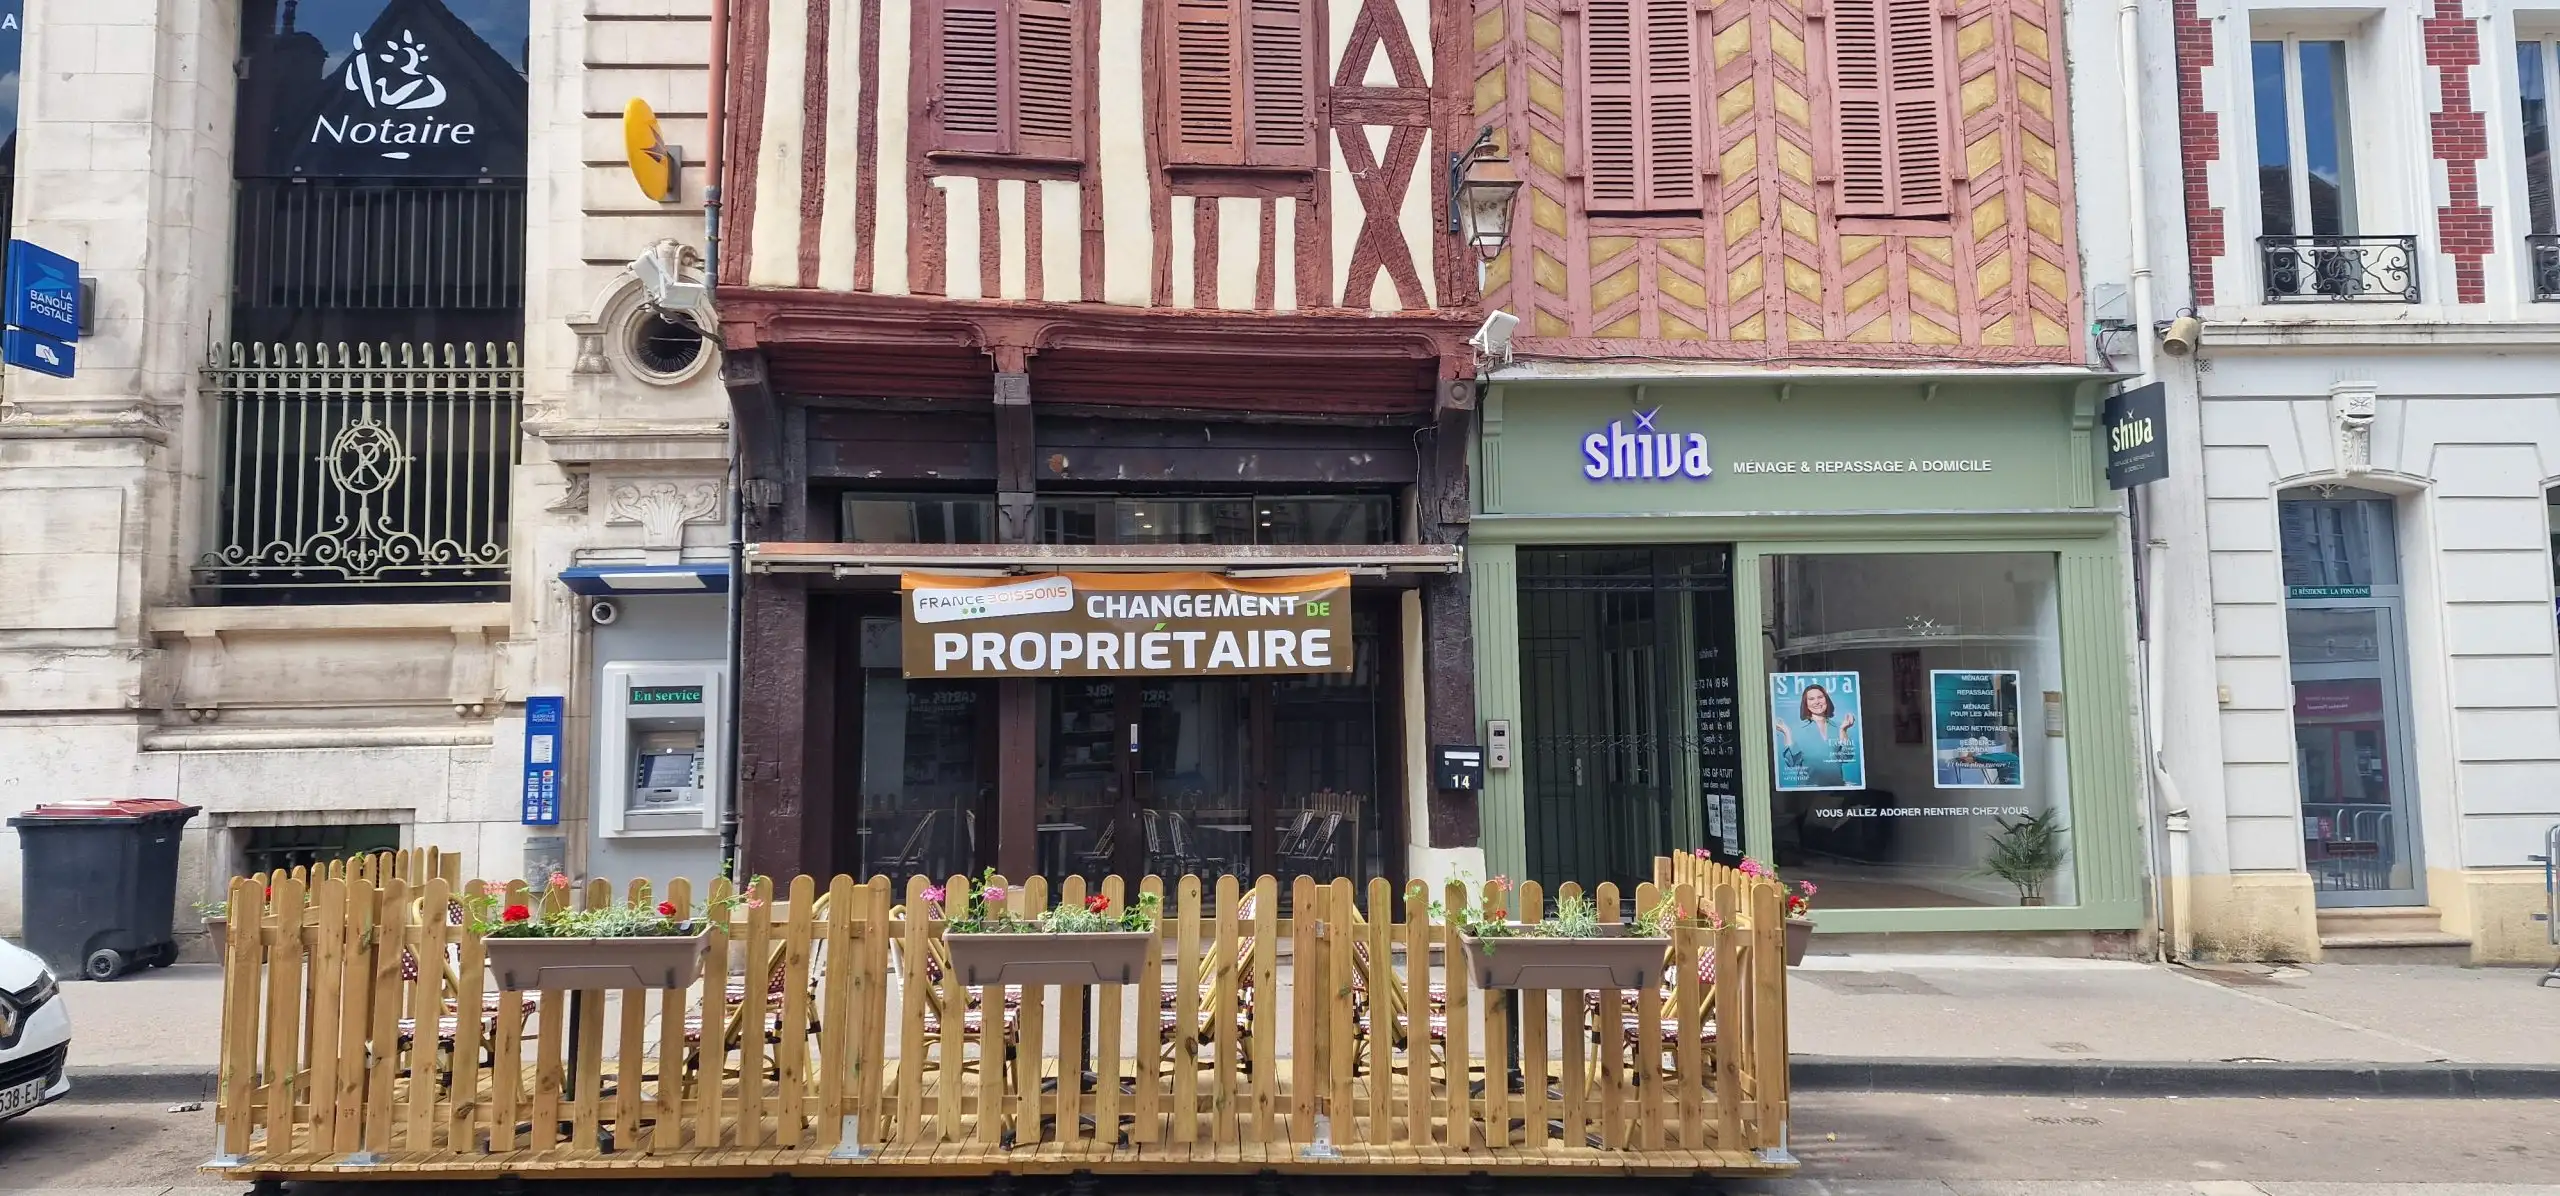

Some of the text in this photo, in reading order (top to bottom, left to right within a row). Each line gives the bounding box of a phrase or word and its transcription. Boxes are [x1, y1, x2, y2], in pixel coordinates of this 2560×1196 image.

[311, 114, 475, 144] Notaire
[30, 289, 73, 313] BANQUE
[59, 288, 73, 302] LA
[30, 301, 73, 324] POSTALE
[1584, 404, 1713, 479] shiva
[2112, 408, 2154, 453] shiva
[1733, 459, 1797, 473] MÉNAGE
[1801, 461, 1811, 473] &
[1815, 460, 1904, 473] REPASSAGE
[1922, 459, 1992, 472] DOMICILE
[919, 595, 985, 610] FRANCE
[1087, 594, 1330, 618] CHANGEMENT DE
[934, 622, 1332, 672] PROPRIÉTAIRE
[634, 689, 700, 701] En service
[1452, 775, 1470, 790] 14
[1816, 806, 2030, 818] VOUS ALLEZ ADORER RENTRER CHEZ VOUS
